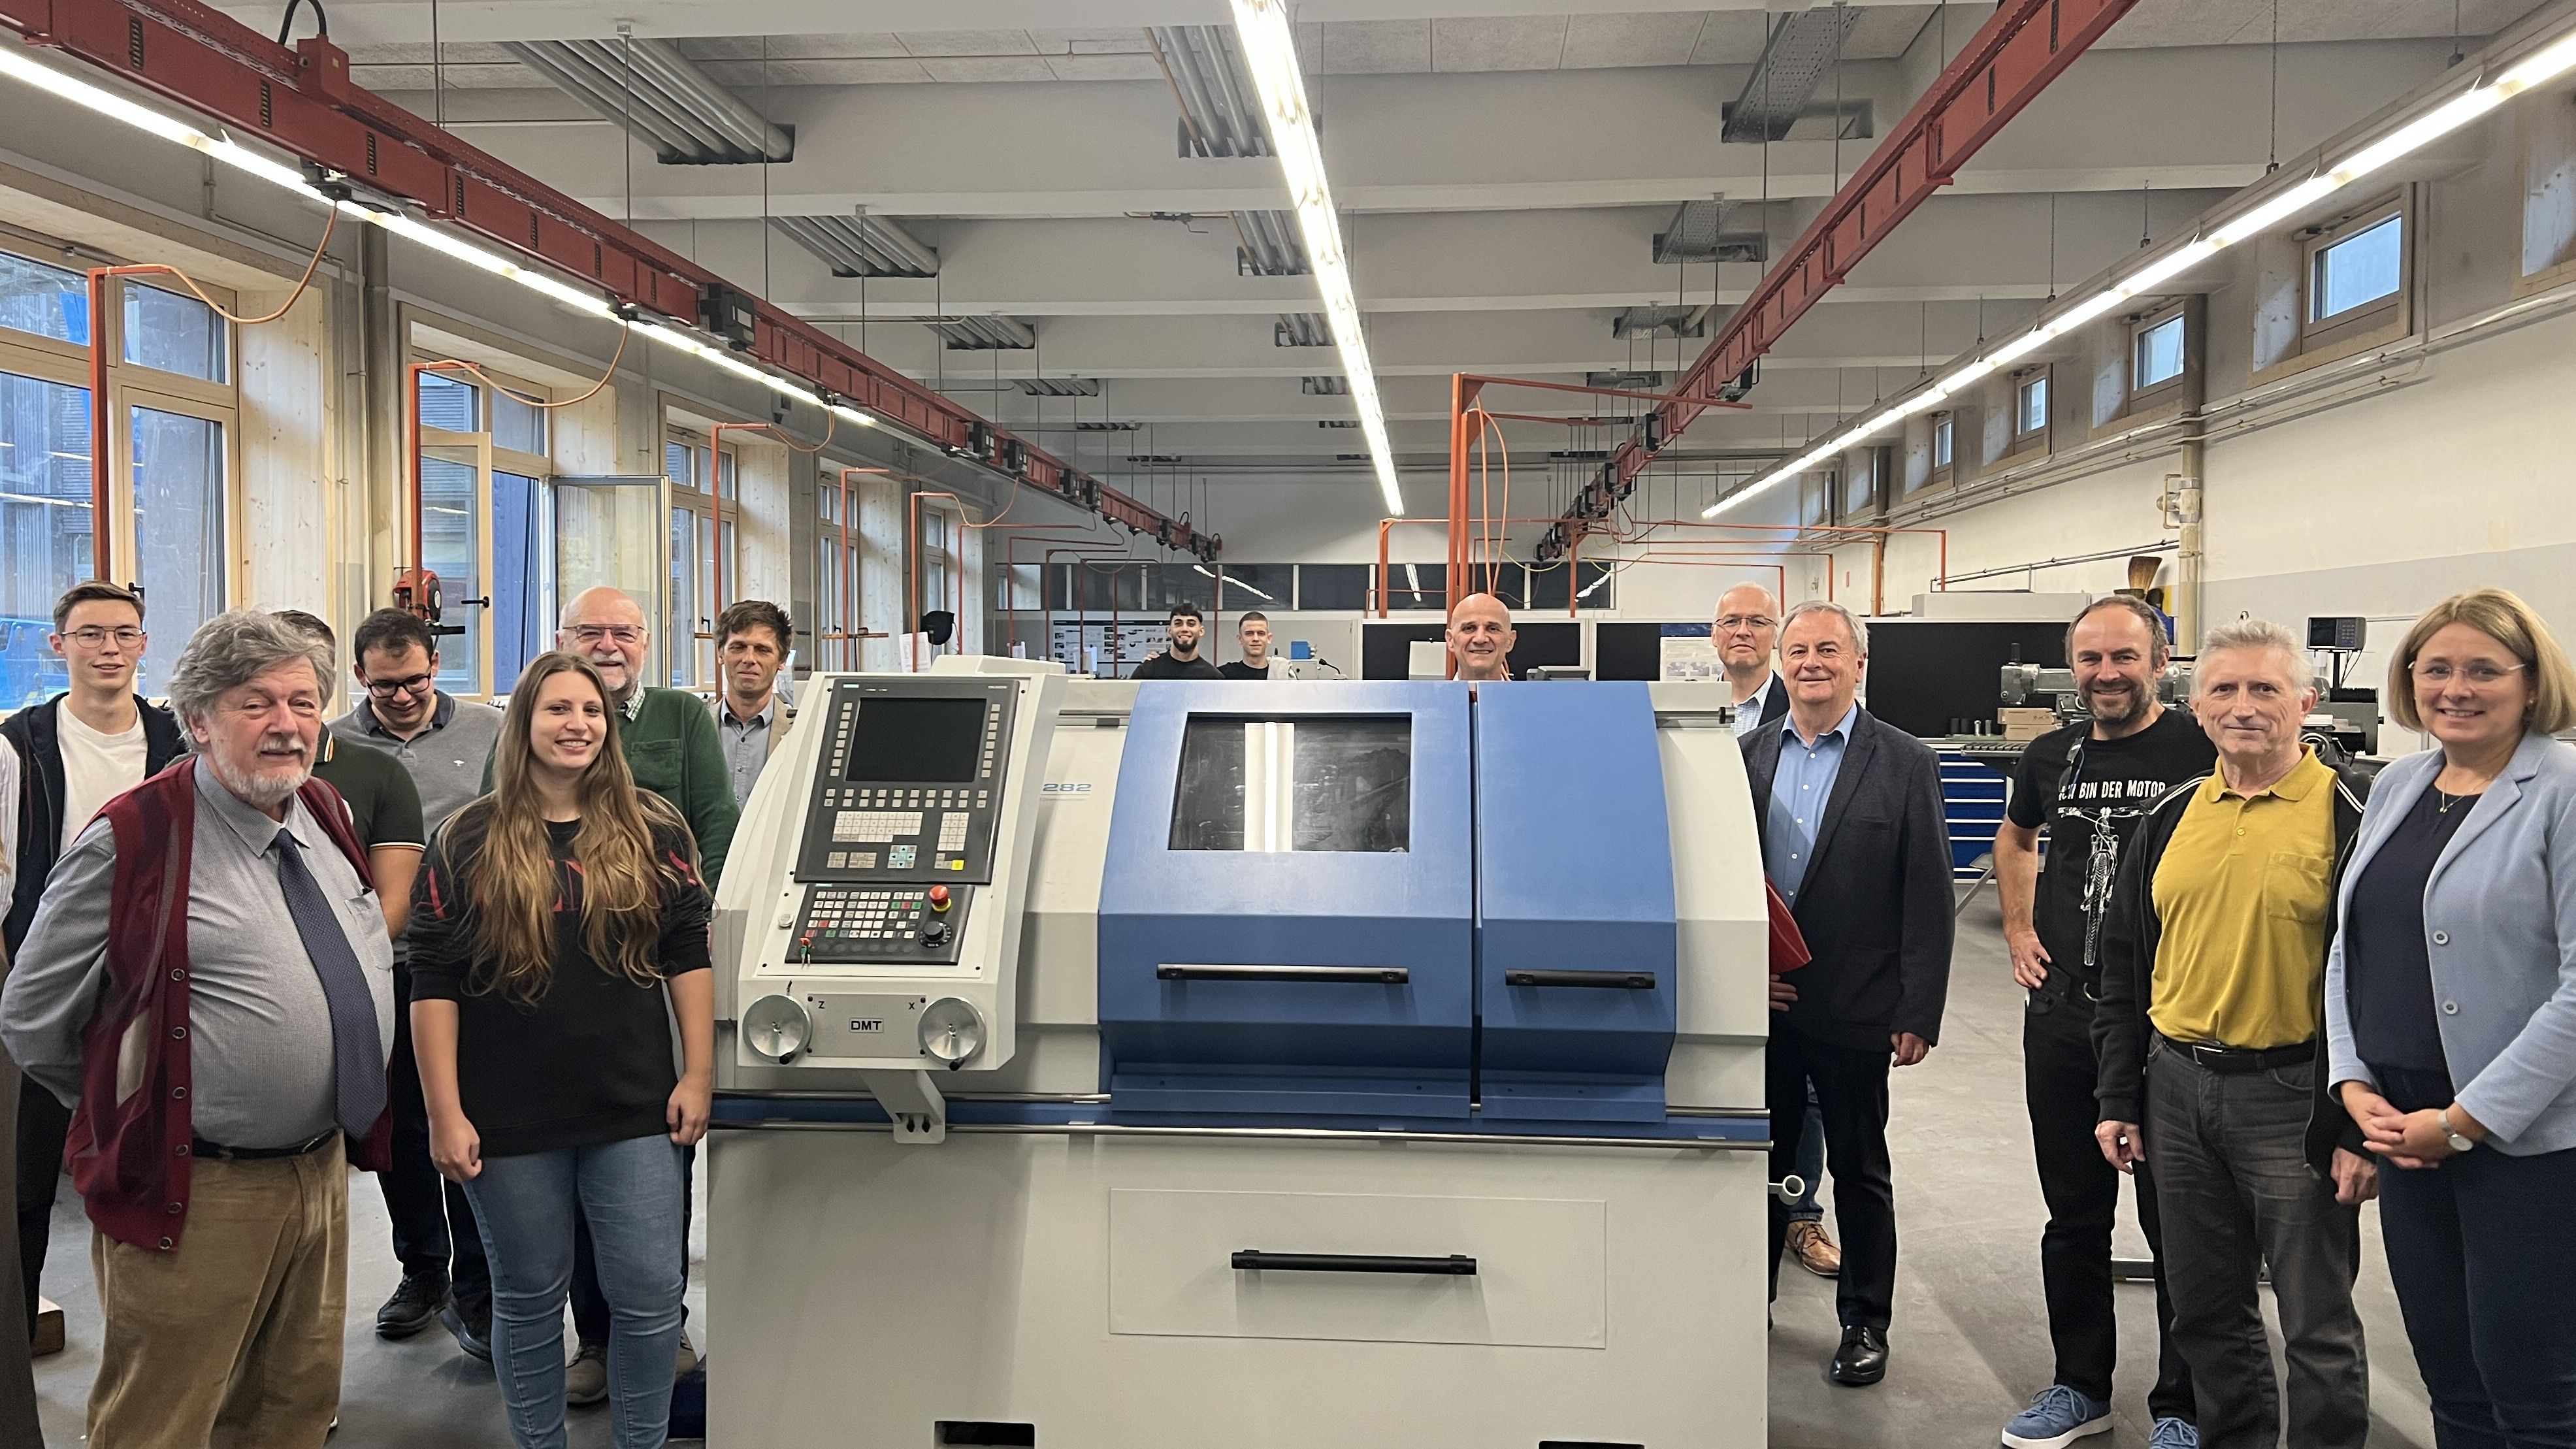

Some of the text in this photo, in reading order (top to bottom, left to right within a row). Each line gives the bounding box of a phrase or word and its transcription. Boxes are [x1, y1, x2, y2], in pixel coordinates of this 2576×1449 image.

[1043, 783, 1092, 792] 282
[2078, 782, 2098, 799] BIN
[2101, 781, 2122, 798] DER
[818, 1001, 825, 1009] Z
[851, 1020, 882, 1030] DMT
